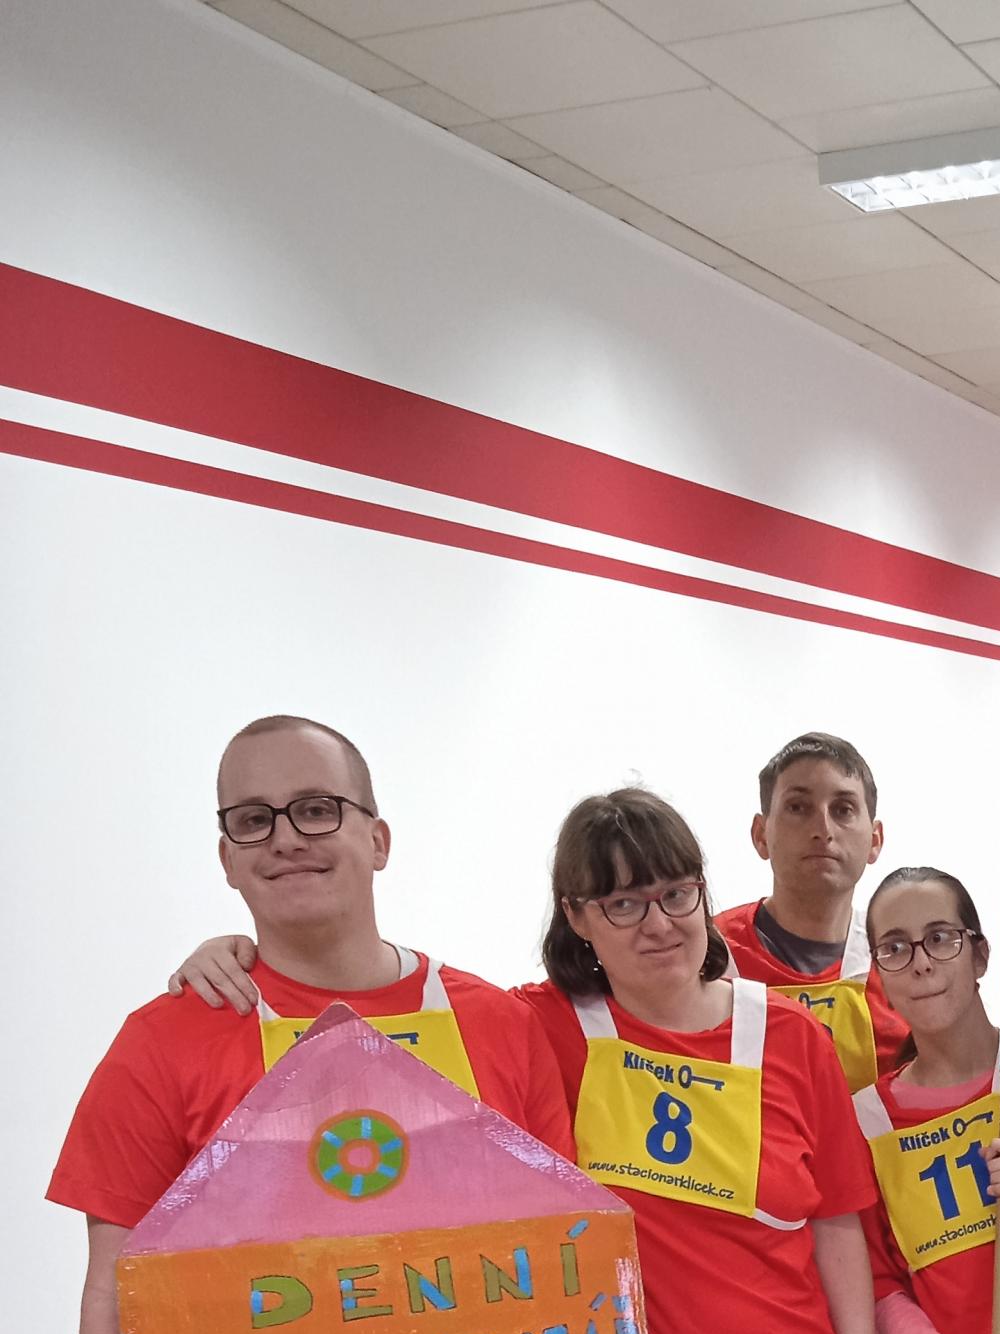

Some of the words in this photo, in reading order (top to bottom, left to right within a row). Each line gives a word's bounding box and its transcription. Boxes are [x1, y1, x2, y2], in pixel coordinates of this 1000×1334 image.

[645, 1091, 693, 1165] 8
[898, 1126, 950, 1153] Klíček
[588, 1162, 735, 1200] www.stacionarklicek.cz
[918, 1140, 998, 1221] 11
[250, 1219, 590, 1330] DENNÍ
